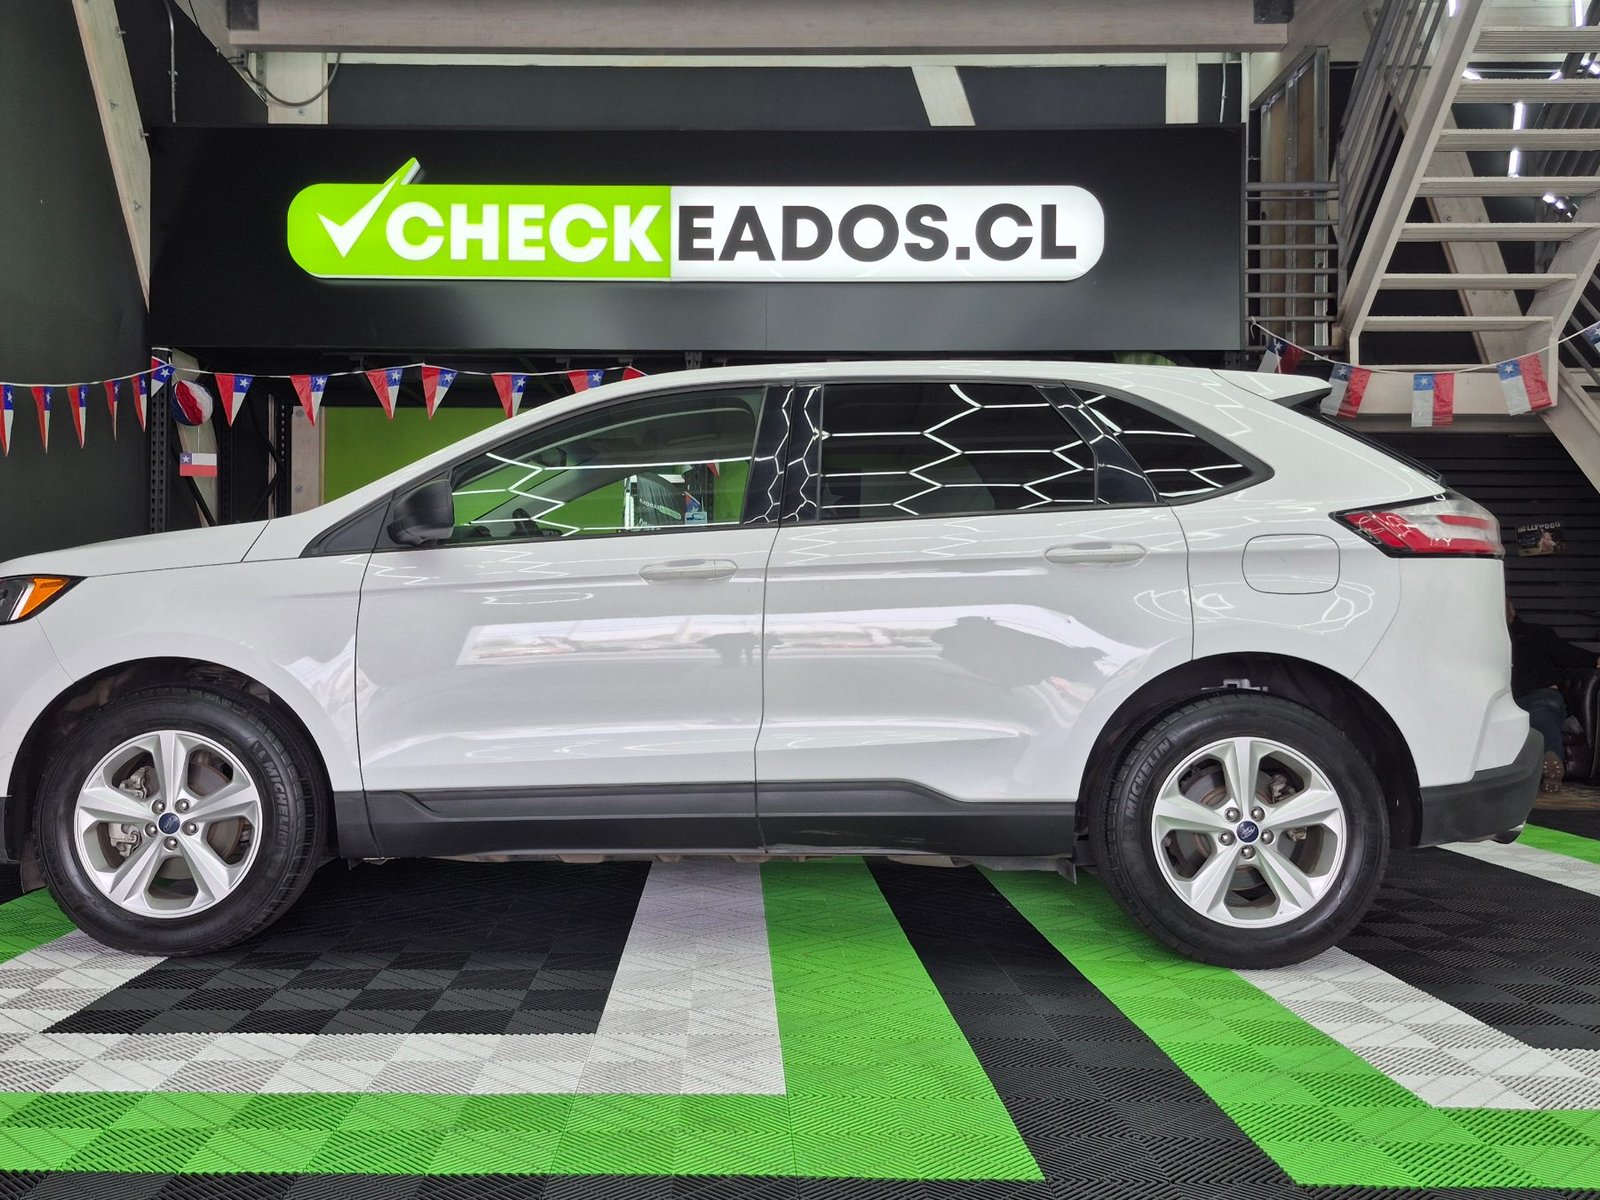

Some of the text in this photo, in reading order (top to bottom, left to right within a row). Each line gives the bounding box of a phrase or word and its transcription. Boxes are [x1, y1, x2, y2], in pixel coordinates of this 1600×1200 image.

[385, 201, 1077, 263] CHECKEADOS.CL
[264, 761, 290, 848] MICHELIN
[1125, 738, 1171, 819] MICHELIN
